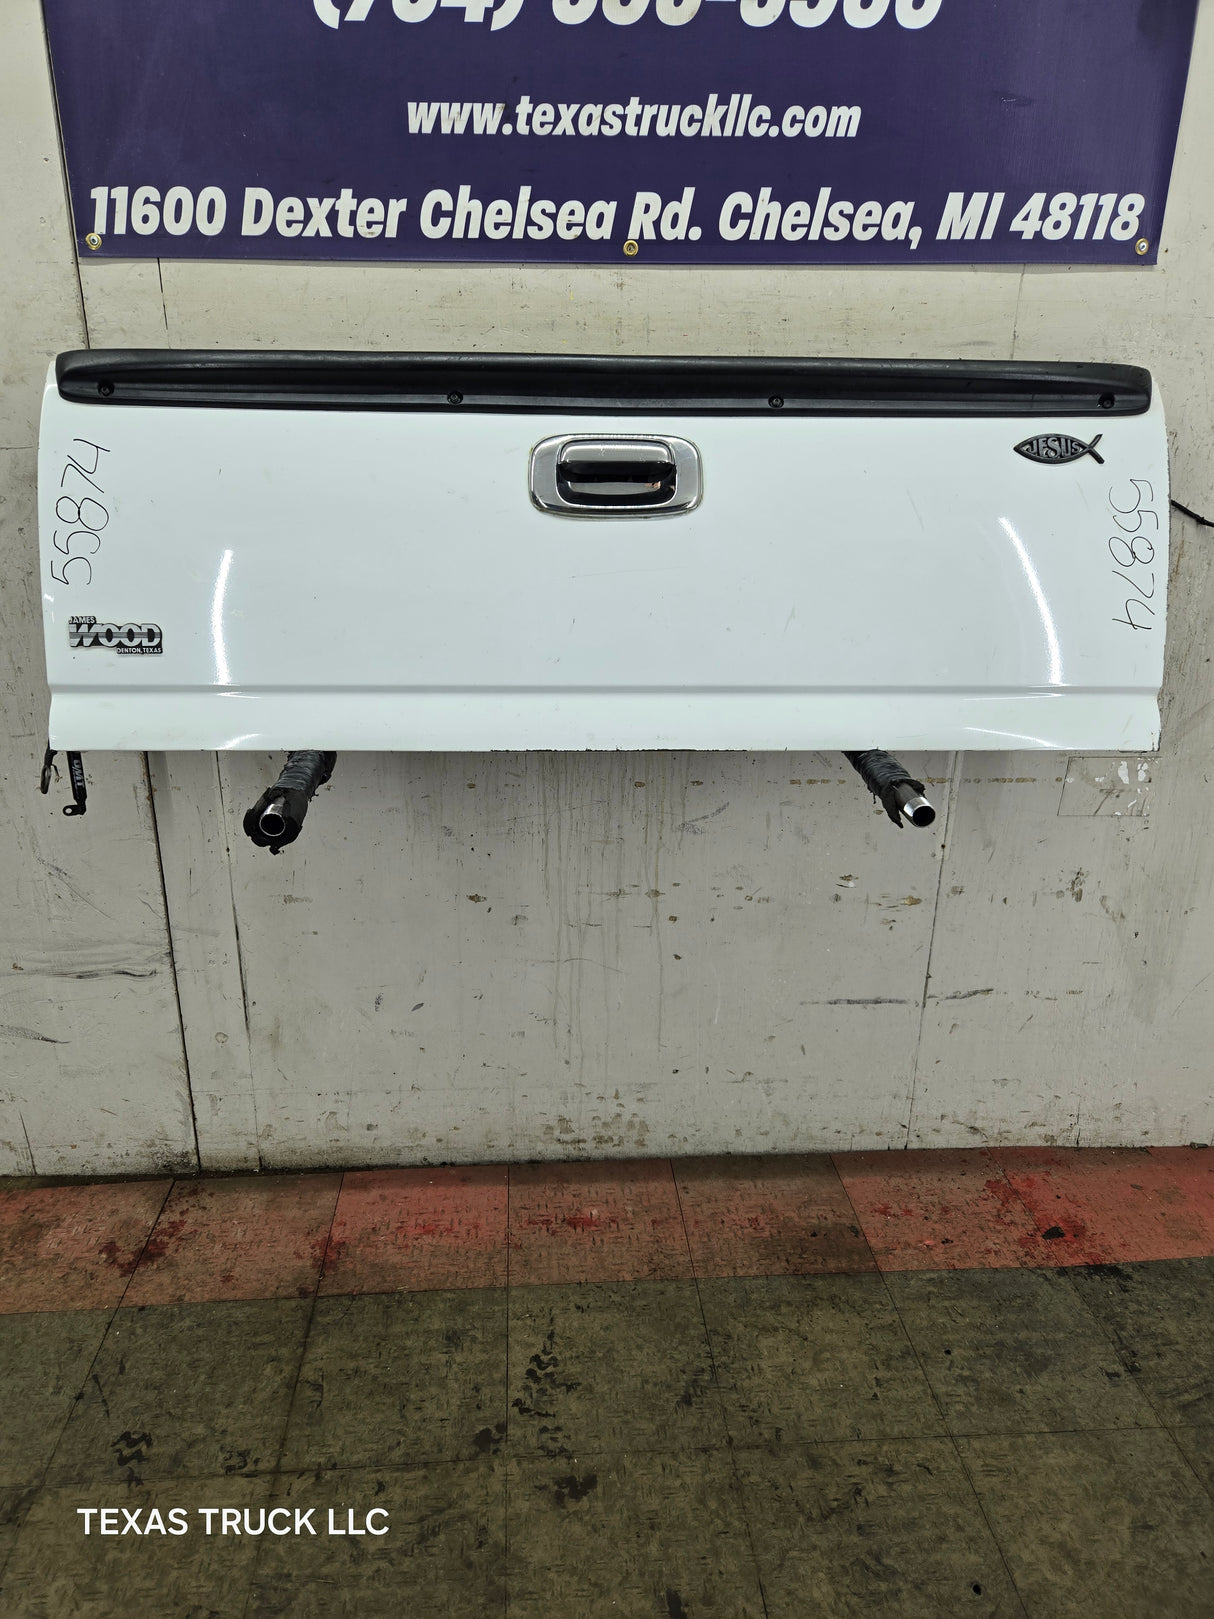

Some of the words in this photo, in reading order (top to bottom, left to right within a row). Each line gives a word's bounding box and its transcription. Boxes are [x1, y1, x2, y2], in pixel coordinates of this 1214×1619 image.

[407, 93, 861, 138] www.texastruckllc.com
[90, 185, 227, 236] 11600
[241, 187, 407, 238] Dexter
[419, 184, 617, 240] Chelsea
[627, 186, 702, 241] Rd.
[718, 186, 922, 250] Chelsea,
[935, 191, 1005, 240] MI
[1009, 192, 1146, 241] 48118
[1023, 436, 1083, 458] JESUS
[51, 438, 111, 586] 55874
[1108, 478, 1159, 630] 55874
[68, 615, 96, 624] JAMES
[68, 623, 162, 647] WOOD
